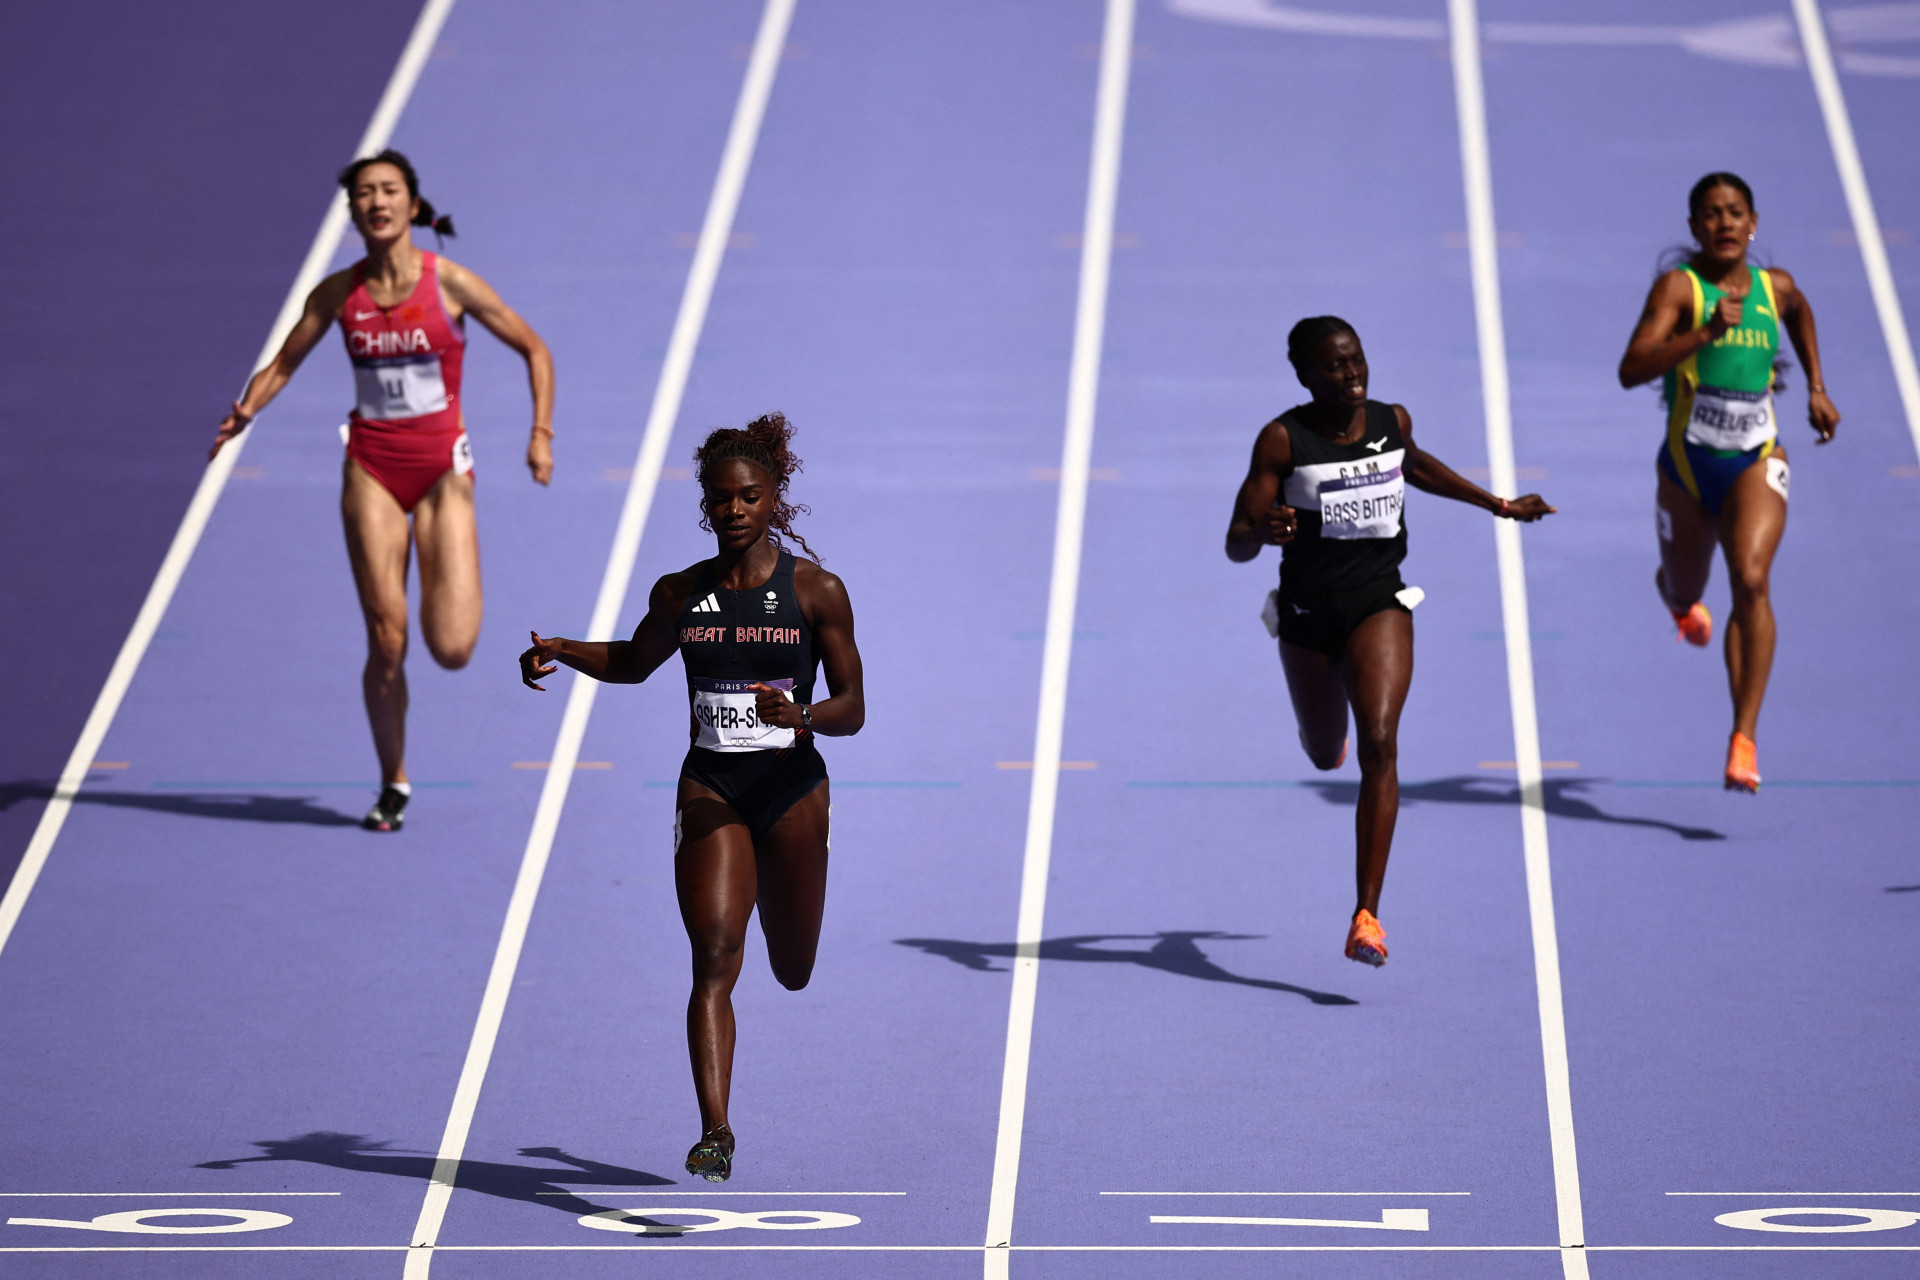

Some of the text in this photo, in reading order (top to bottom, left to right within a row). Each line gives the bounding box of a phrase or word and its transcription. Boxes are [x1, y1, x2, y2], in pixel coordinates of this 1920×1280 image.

[350, 328, 431, 355] CHINA
[1324, 501, 1359, 524] BASS
[680, 627, 800, 644] GREAT BRITAIN
[578, 1208, 861, 1232] 8
